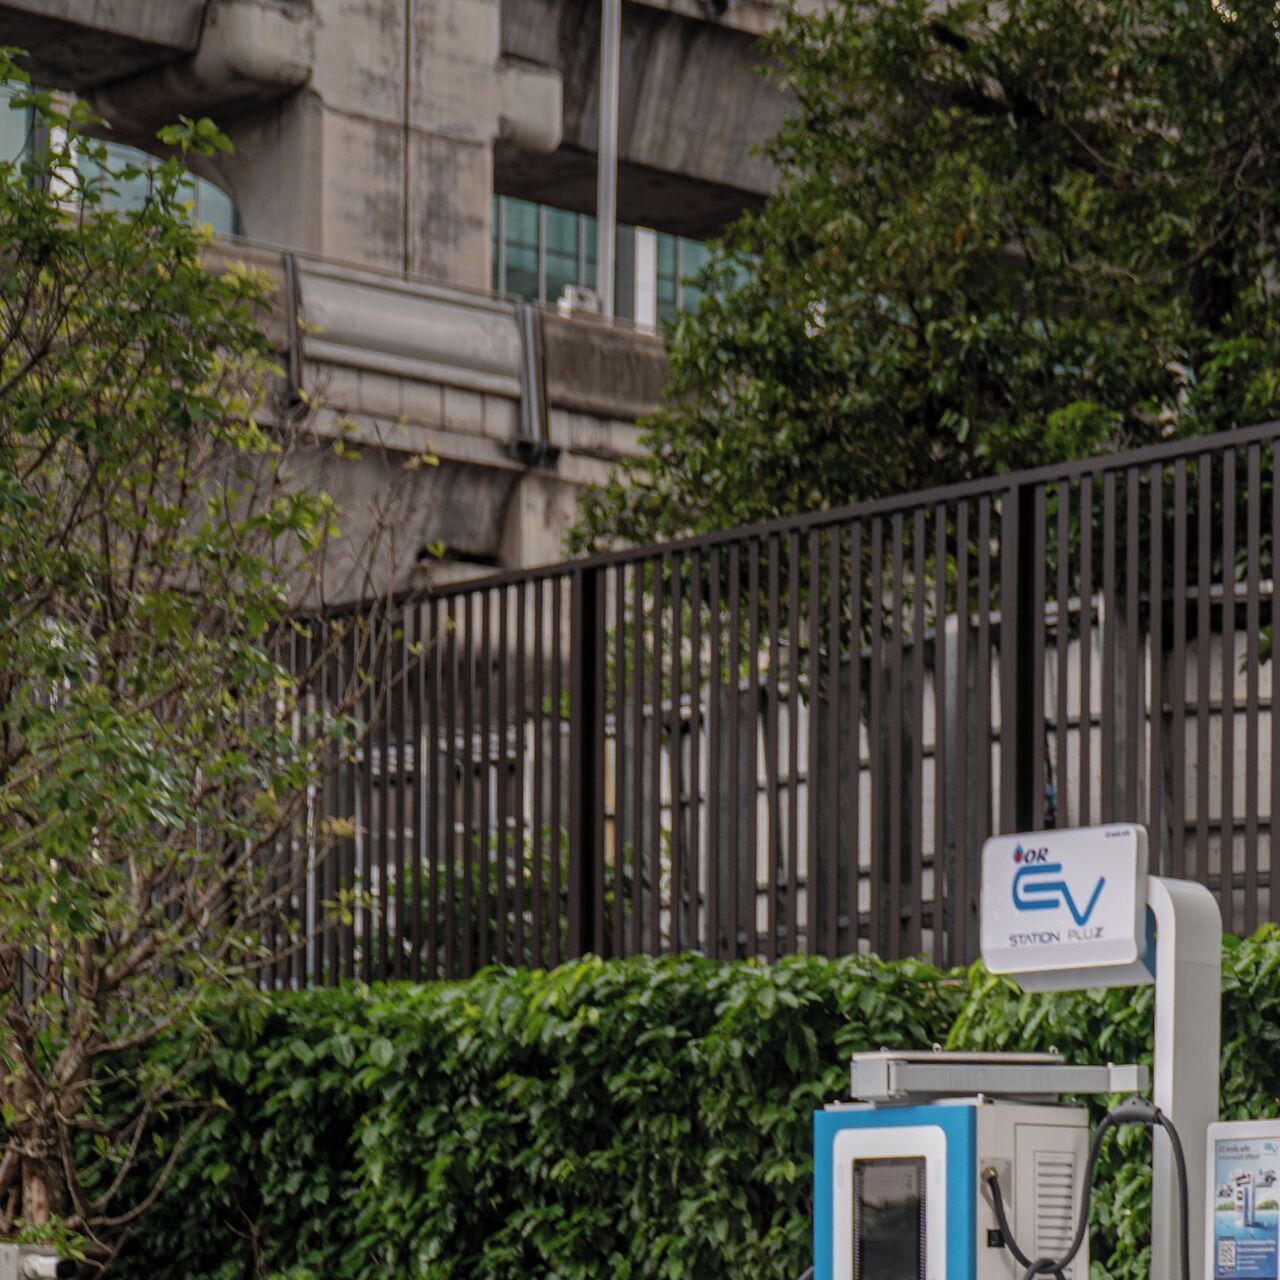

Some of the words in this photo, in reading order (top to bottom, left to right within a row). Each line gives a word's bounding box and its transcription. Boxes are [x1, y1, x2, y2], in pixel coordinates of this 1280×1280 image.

[1024, 848, 1049, 864] OR
[1012, 863, 1105, 927] EV
[1009, 931, 1060, 947] STATION
[1067, 926, 1105, 942] PLUZ
